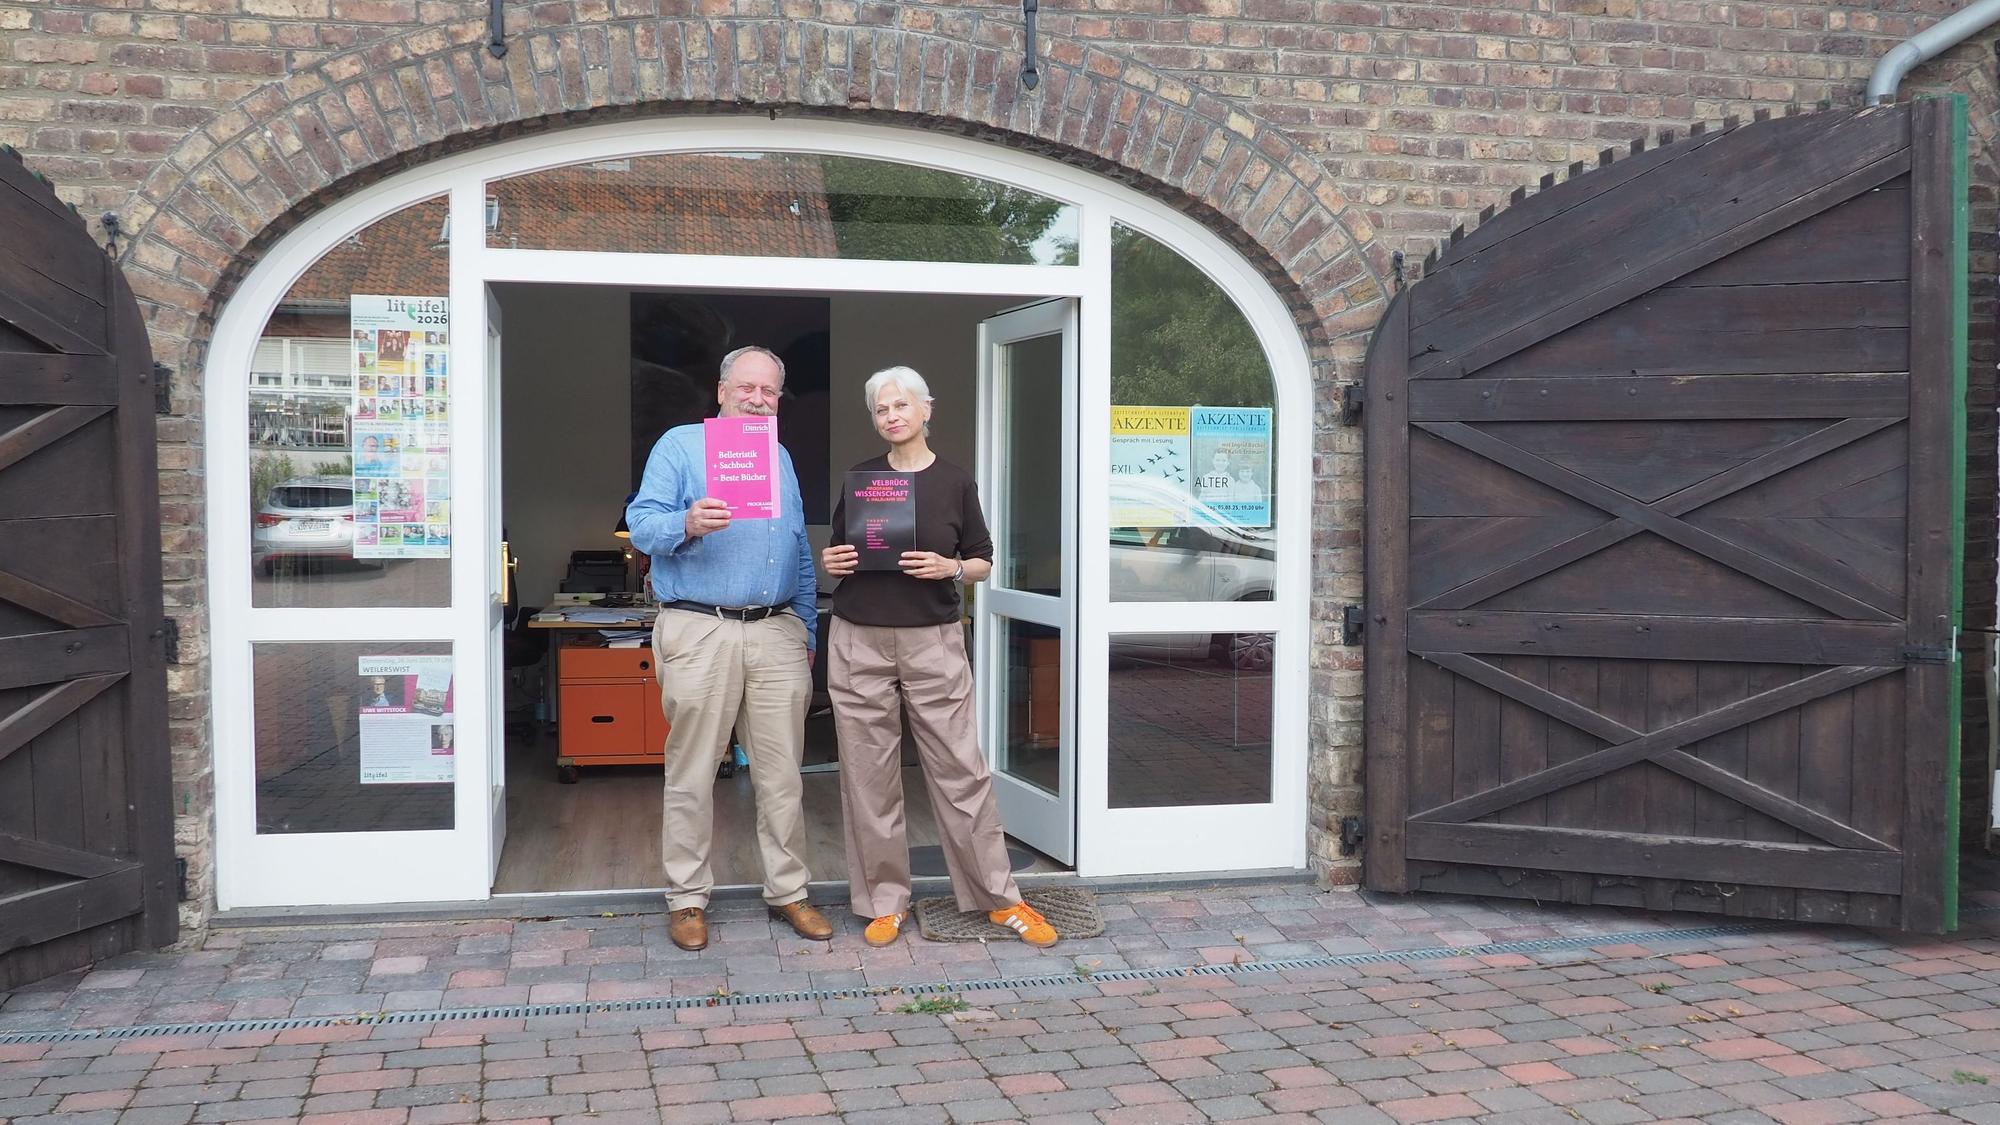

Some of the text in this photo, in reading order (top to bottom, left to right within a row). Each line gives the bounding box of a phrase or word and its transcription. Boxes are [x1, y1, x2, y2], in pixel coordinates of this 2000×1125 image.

[418, 315, 447, 324] 2026
[1113, 417, 1186, 430] AKZENTE
[1197, 413, 1266, 426] AKZENTE
[718, 451, 758, 459] Belletristik
[1194, 476, 1229, 488] ALTER
